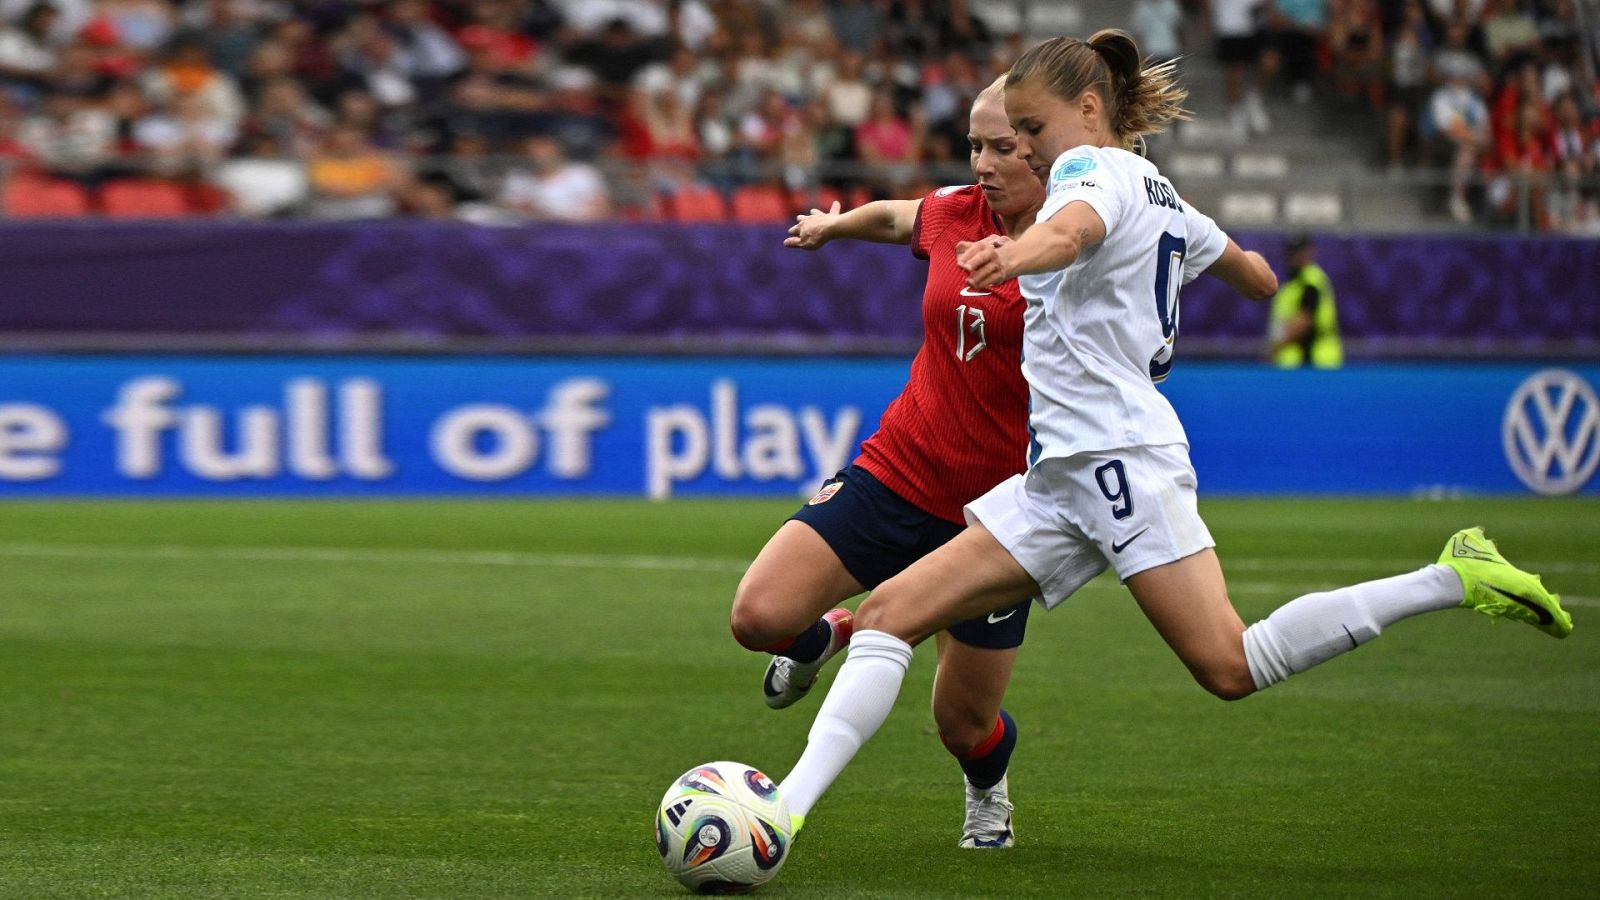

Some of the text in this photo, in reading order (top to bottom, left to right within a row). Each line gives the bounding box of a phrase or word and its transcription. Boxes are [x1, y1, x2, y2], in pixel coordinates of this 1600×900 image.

[956, 304, 987, 363] 13
[103, 376, 394, 480] full
[429, 377, 611, 481] of
[647, 378, 861, 499] play
[1094, 459, 1134, 521] 9
